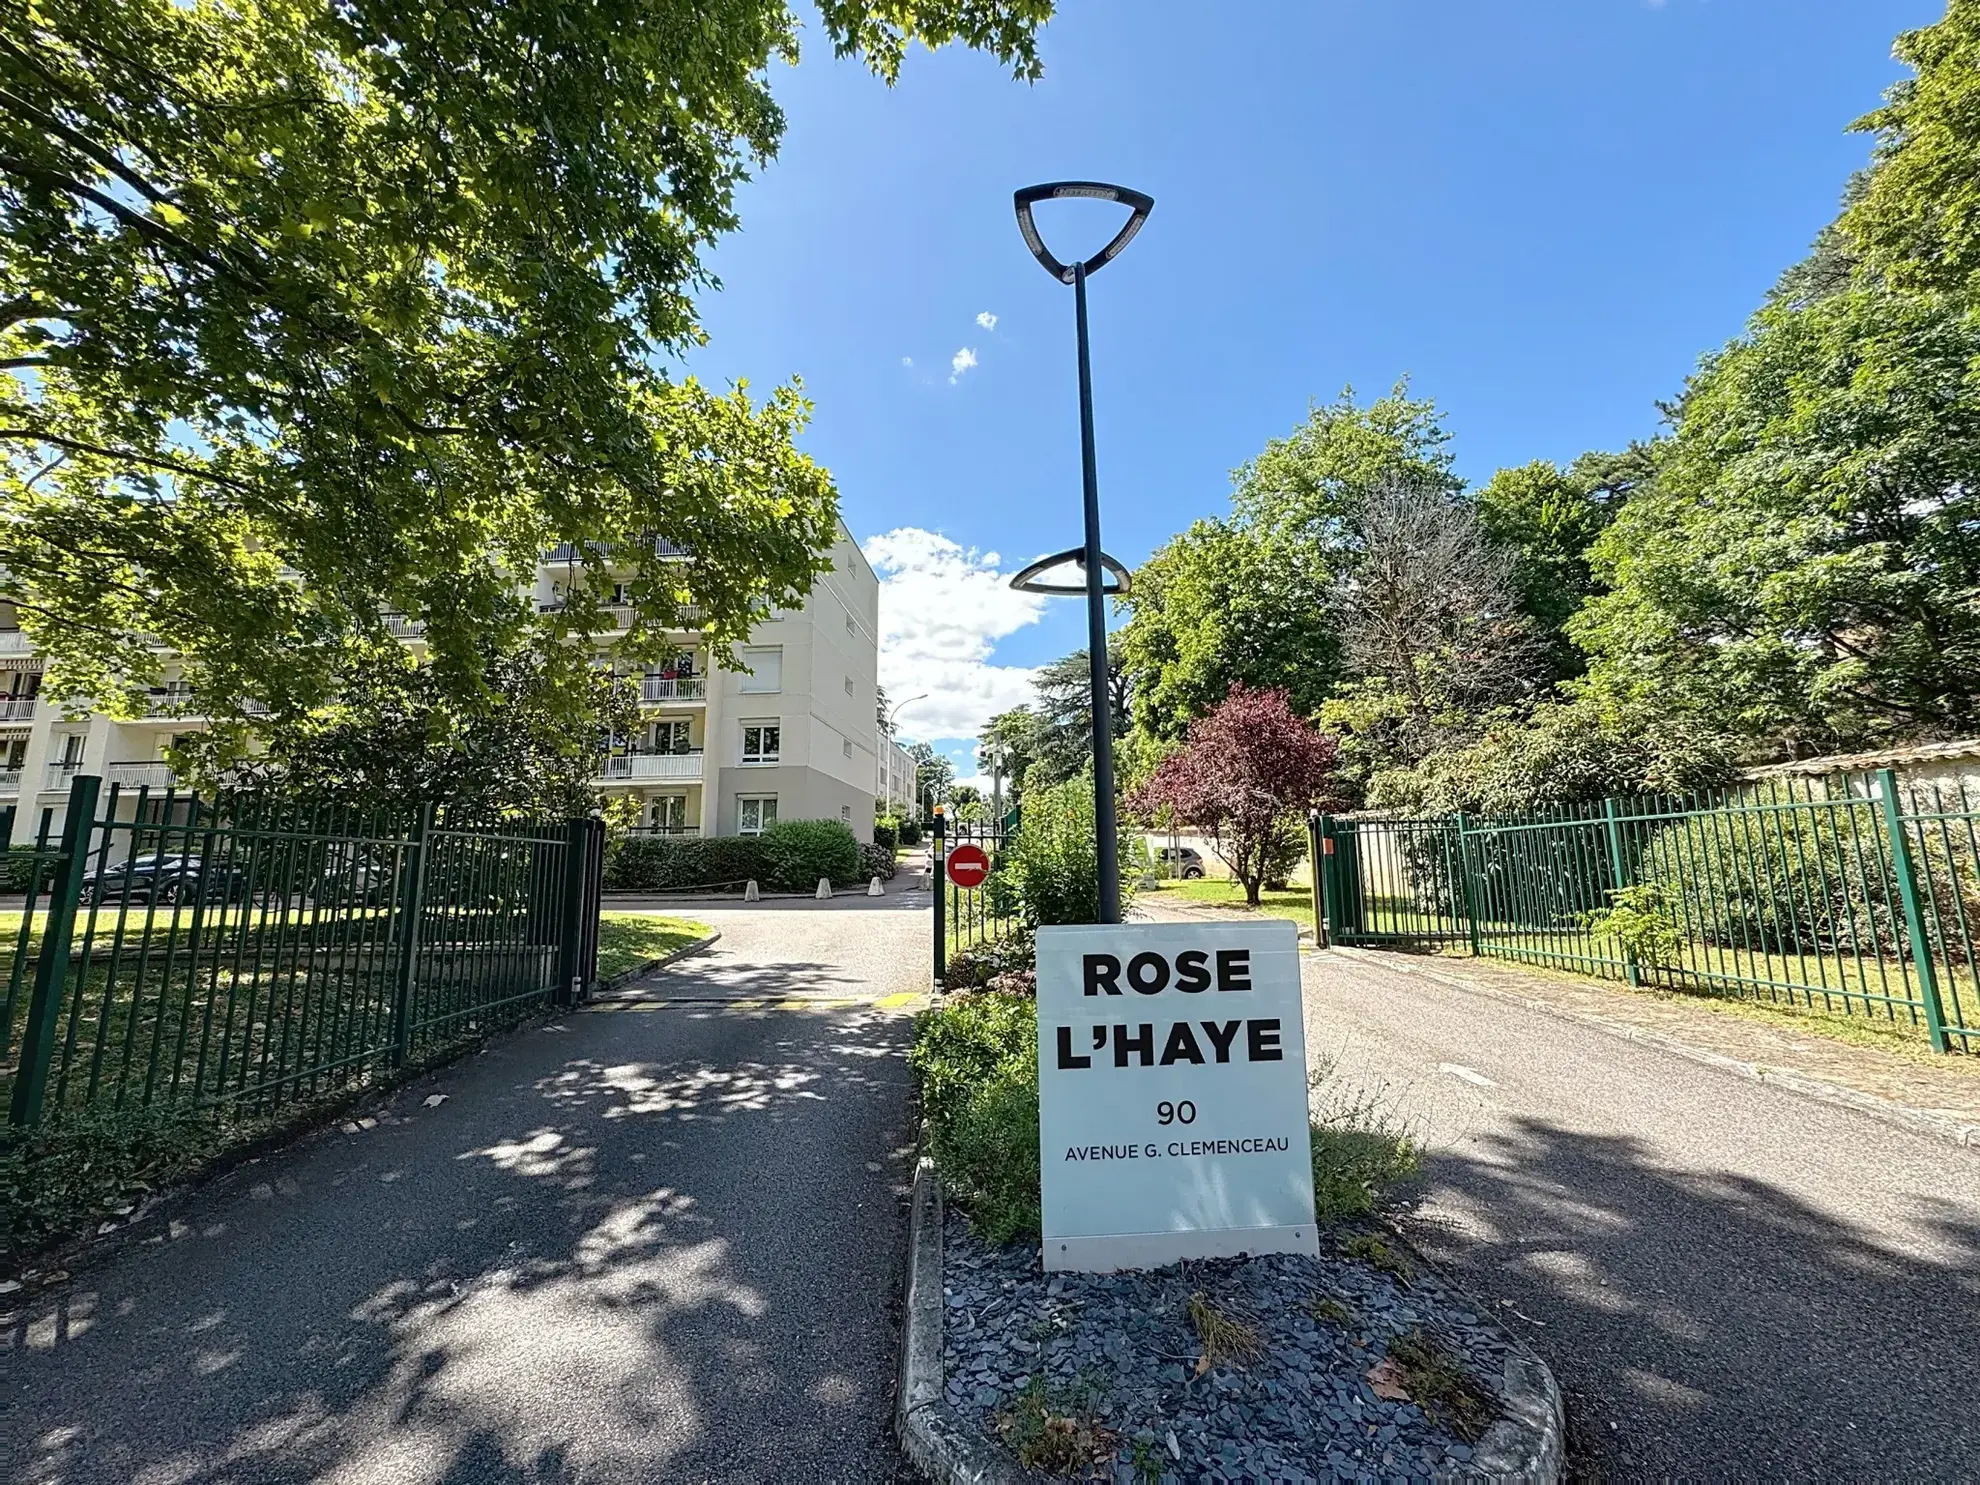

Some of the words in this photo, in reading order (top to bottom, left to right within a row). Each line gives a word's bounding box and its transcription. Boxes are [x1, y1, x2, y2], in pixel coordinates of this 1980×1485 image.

[1082, 949, 1252, 997] ROSE
[1056, 1018, 1284, 1070] L'HAYE
[1156, 1100, 1197, 1126] 90
[1064, 1144, 1139, 1162] AVENUE
[1144, 1142, 1162, 1158] G.
[1167, 1136, 1289, 1157] CLEMENCEAU
